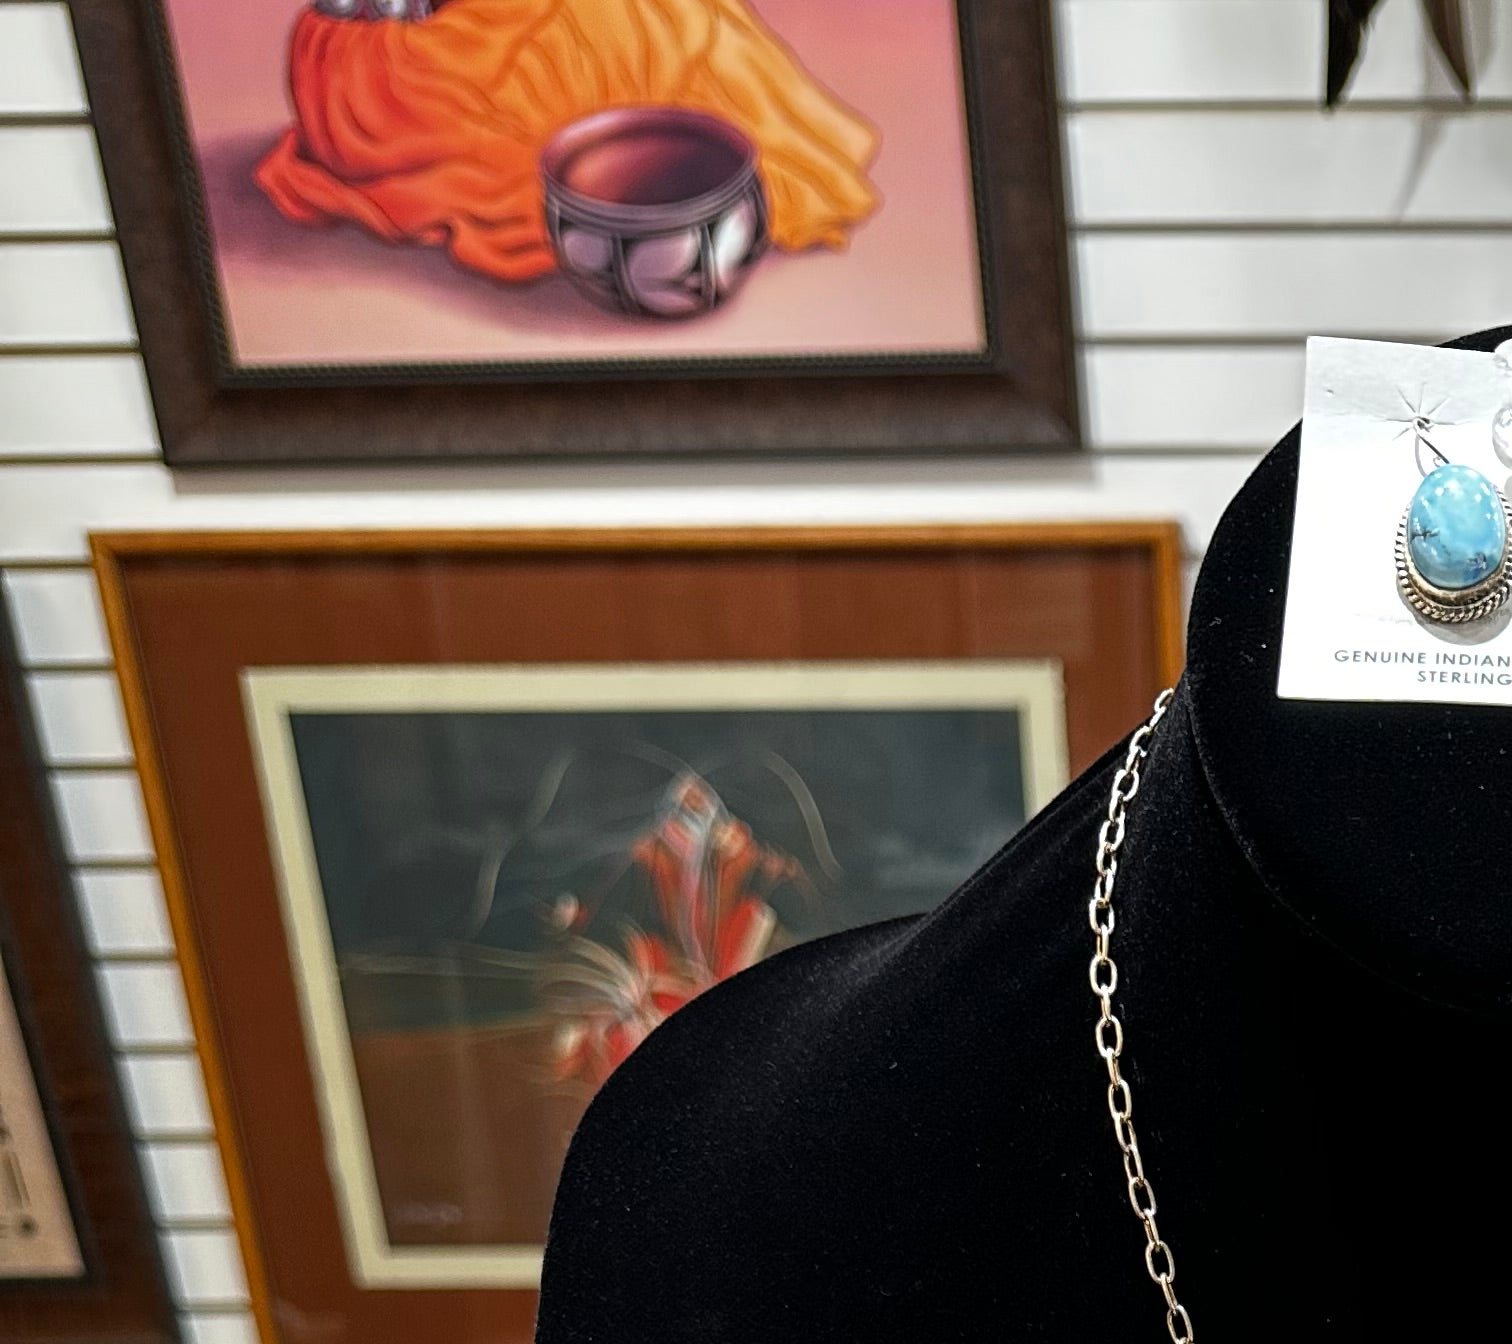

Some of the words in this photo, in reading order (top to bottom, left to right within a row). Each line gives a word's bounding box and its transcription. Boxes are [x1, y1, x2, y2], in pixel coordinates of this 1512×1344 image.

[1334, 649, 1427, 664] GENUINE
[1435, 652, 1510, 667] INDIAN
[1417, 670, 1512, 685] STERLING
